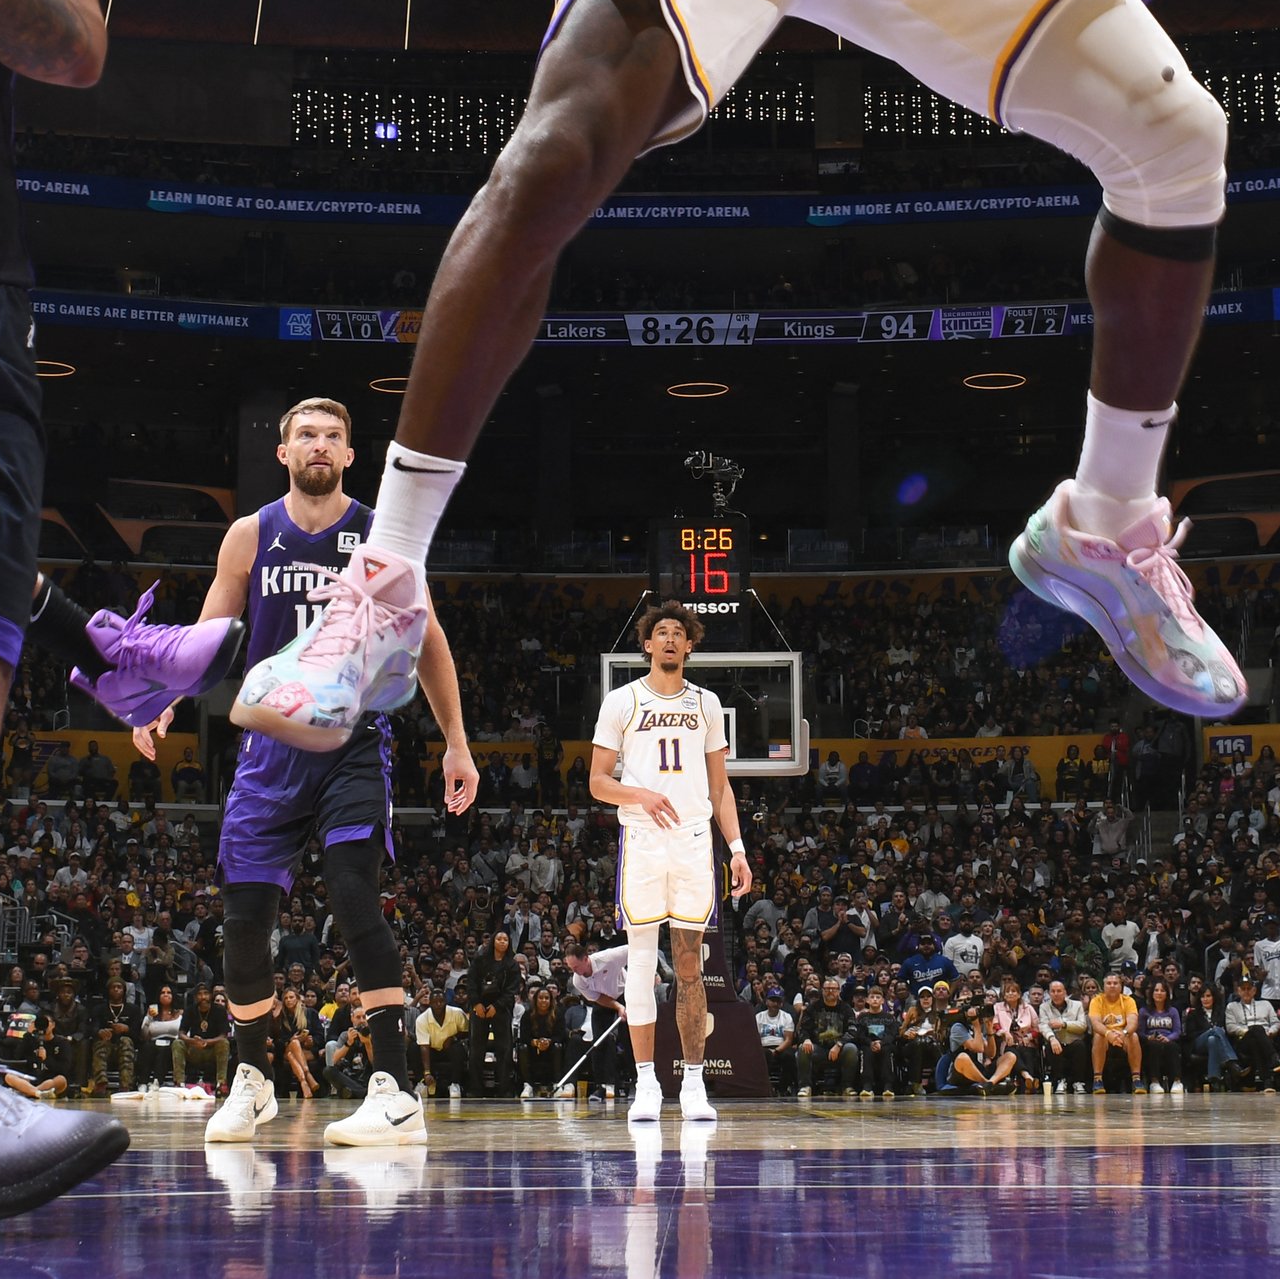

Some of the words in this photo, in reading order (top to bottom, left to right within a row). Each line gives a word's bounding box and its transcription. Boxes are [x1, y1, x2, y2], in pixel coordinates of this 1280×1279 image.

[1226, 180, 1242, 194] AT
[150, 190, 193, 204] LEARN
[196, 193, 233, 208] MORE
[235, 196, 252, 209] AT
[255, 198, 422, 215] GO.AMEX/CRYPTO-ARENA
[809, 206, 851, 217] LEARN
[855, 204, 892, 216] MORE
[894, 202, 911, 214] AT
[914, 195, 1080, 213] GO.AMEX/CRYPTO-ARENA
[59, 304, 101, 317] GAMES
[104, 307, 128, 319] ARE
[130, 308, 175, 323] BETTER
[178, 312, 249, 328] #WITHAMEX
[326, 313, 342, 322] TOL
[331, 323, 343, 338] 4
[360, 323, 371, 338] 0
[547, 323, 606, 338] Lakers
[642, 317, 714, 344] 8:26
[784, 321, 835, 338] Kings
[880, 314, 917, 339] 94
[943, 318, 991, 331] KINGS
[1014, 319, 1025, 335] 2
[1045, 318, 1056, 333] 2
[737, 324, 750, 343] 4
[681, 528, 732, 550] 8:26
[690, 553, 729, 593] 16
[683, 602, 740, 614] TISSOT
[635, 709, 699, 732] LAKERS
[1216, 738, 1246, 754] 116
[658, 738, 683, 773] 11
[913, 967, 943, 981] Dodgers
[673, 1059, 732, 1069] PEANGA
